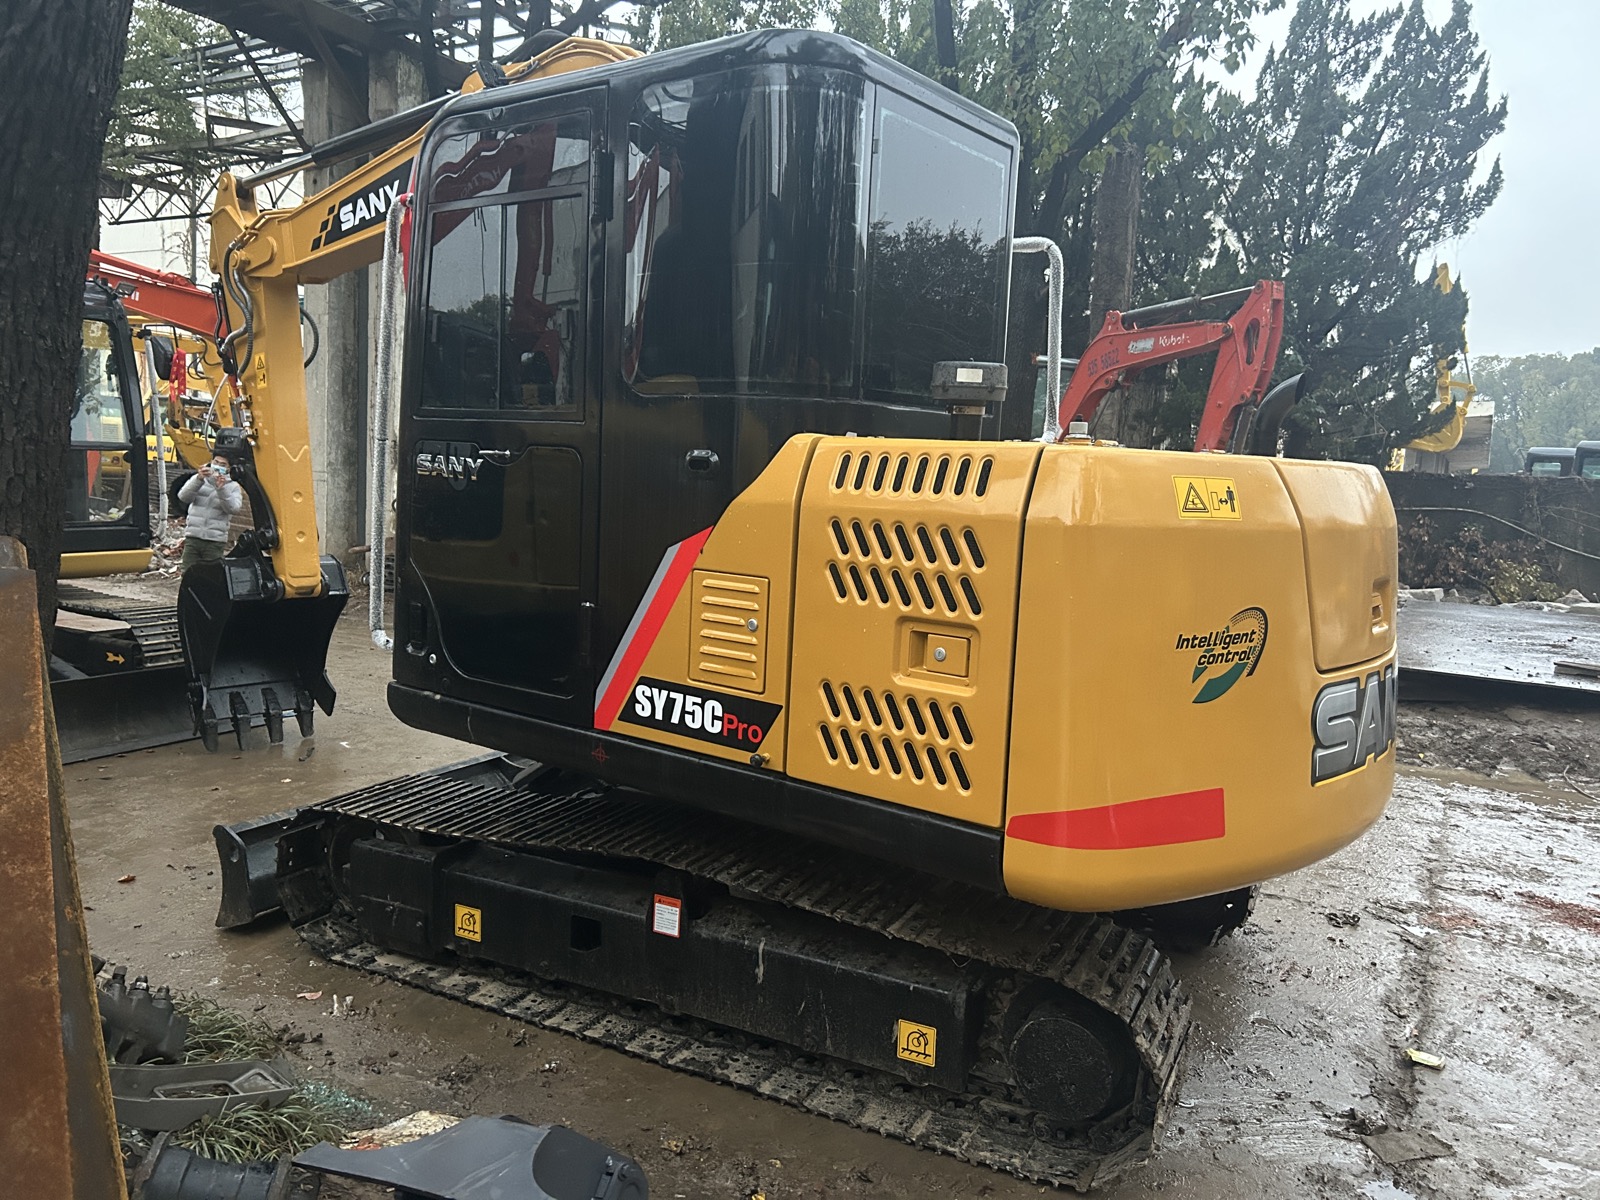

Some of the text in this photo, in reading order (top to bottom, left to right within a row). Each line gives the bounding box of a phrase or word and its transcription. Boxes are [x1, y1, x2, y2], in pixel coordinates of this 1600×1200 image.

[339, 179, 400, 232] SANY
[416, 453, 484, 481] SANY
[1175, 629, 1257, 650] Intelligent
[1197, 646, 1252, 666] control
[1311, 665, 1397, 787] SAN
